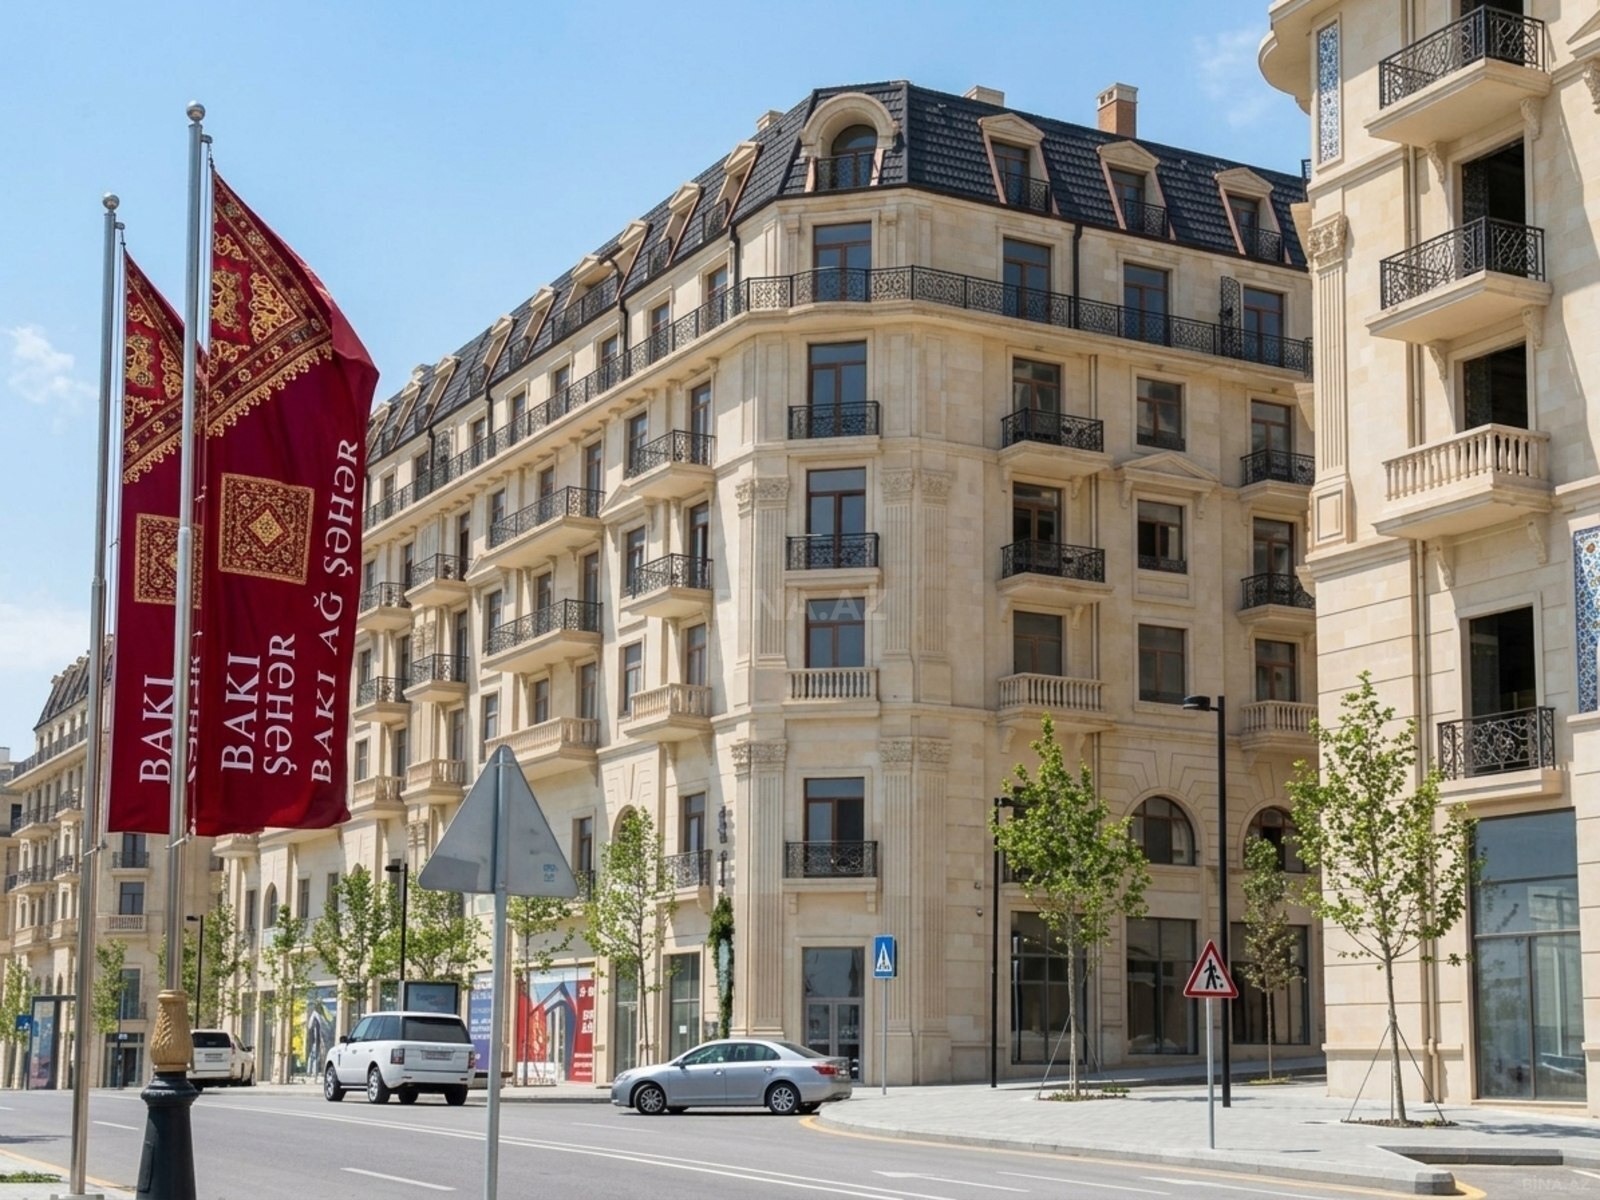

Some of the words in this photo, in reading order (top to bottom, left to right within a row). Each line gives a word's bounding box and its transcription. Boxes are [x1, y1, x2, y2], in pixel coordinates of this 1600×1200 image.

[323, 439, 358, 577] ŞƏHƏR
[313, 591, 344, 656] AĞ
[139, 674, 174, 784] BAKI
[220, 651, 261, 774] BAKI
[262, 633, 298, 776] ŞƏHƏR
[311, 670, 336, 783] BAKI
